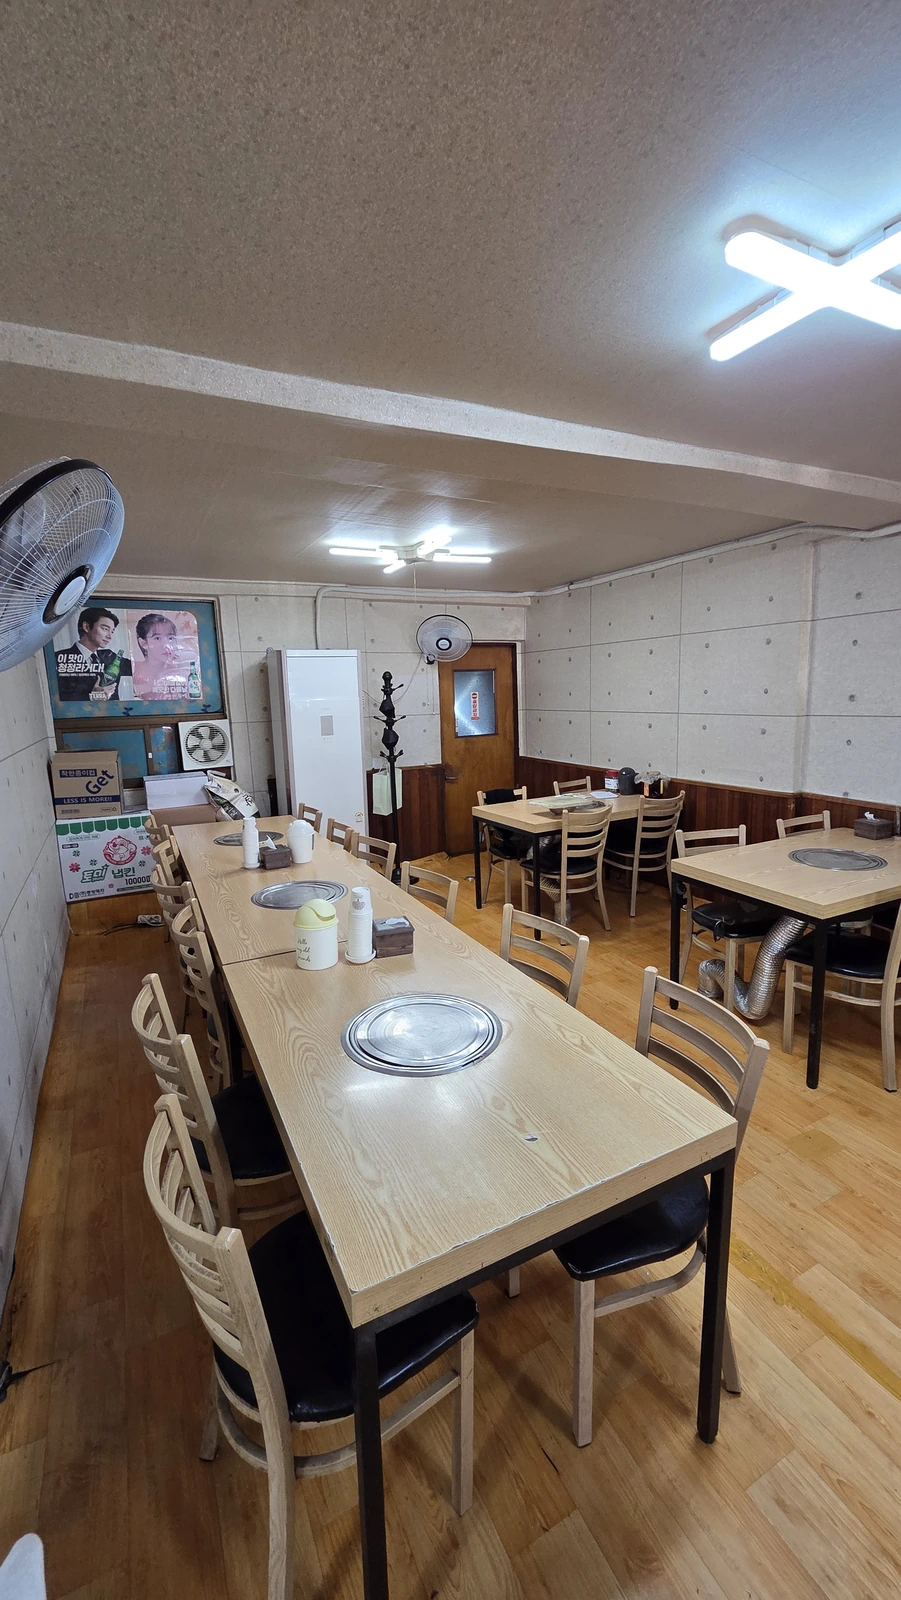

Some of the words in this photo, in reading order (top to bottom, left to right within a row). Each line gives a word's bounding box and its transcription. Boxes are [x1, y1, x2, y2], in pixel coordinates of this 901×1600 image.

[57, 653, 67, 663] 이
[68, 653, 86, 663] 맛이
[85, 769, 114, 795] Get
[112, 867, 136, 879] 냅킨
